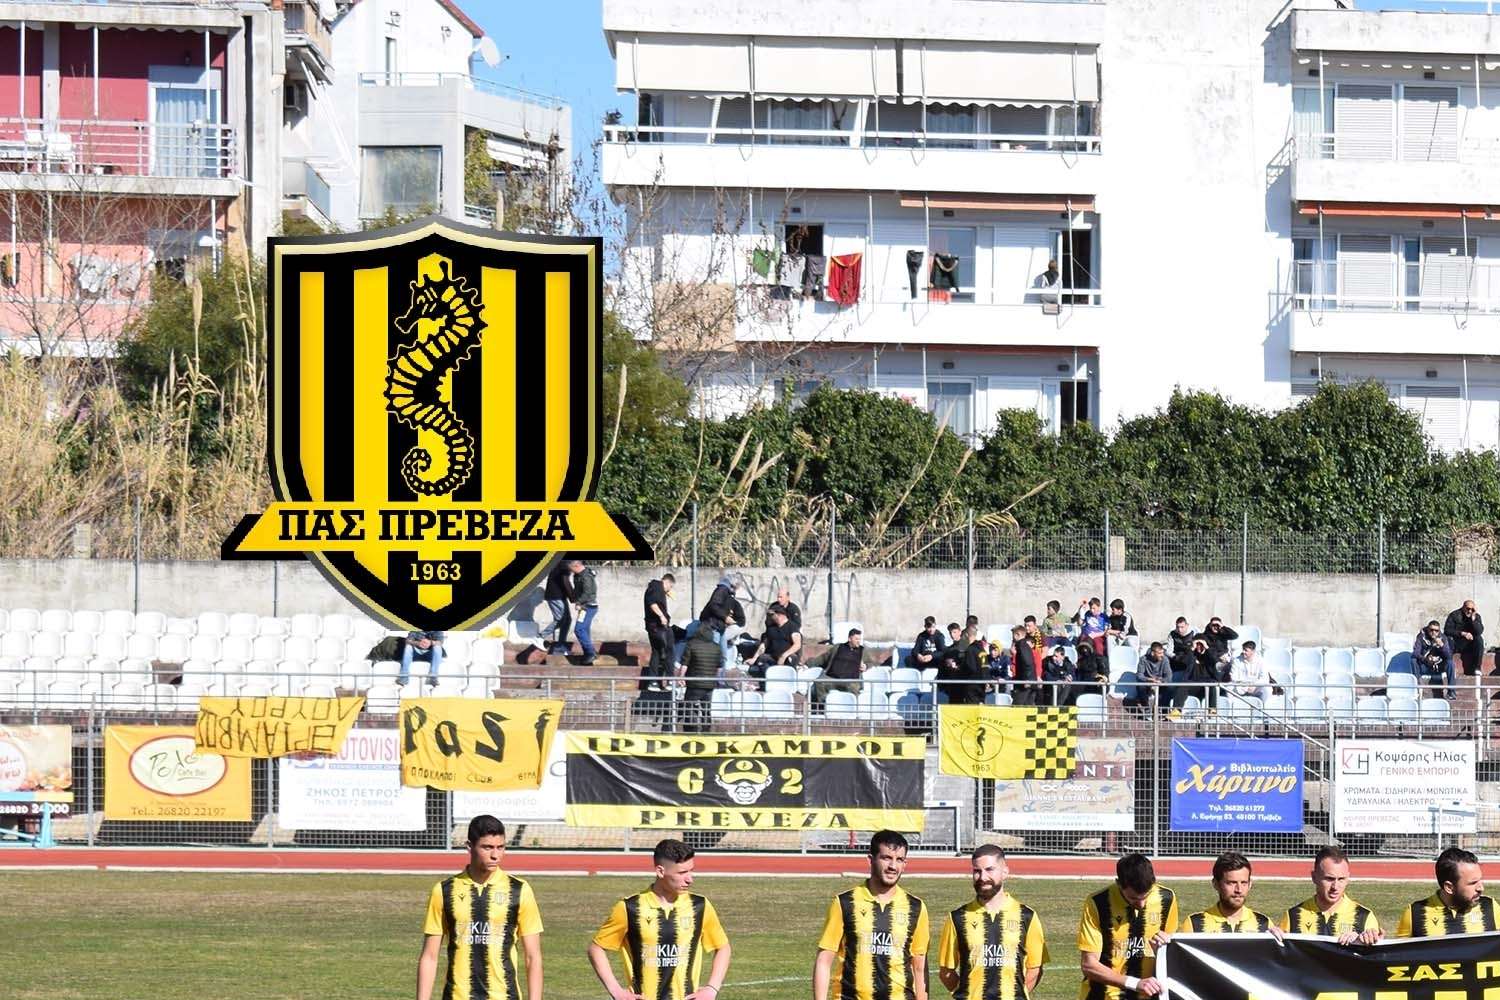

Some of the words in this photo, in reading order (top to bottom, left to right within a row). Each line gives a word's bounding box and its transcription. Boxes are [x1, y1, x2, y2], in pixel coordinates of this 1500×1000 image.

[587, 736, 905, 757] IPPOKAMPOI
[1375, 751, 1430, 764] Κοψάρης
[1433, 751, 1468, 764] Ηλίας
[972, 764, 991, 773] 1963
[1230, 763, 1297, 774] Βιβλιοπωλείο
[1417, 767, 1460, 776] ΕΜΠΟΡΙΟ
[677, 767, 705, 795] G
[779, 767, 804, 795] 2
[1175, 764, 1298, 800] Χάρτινο
[157, 807, 191, 816] 26820
[194, 807, 226, 816] 22197
[639, 810, 850, 828] PREVEZA
[1387, 962, 1464, 982] ΣΑΣ
